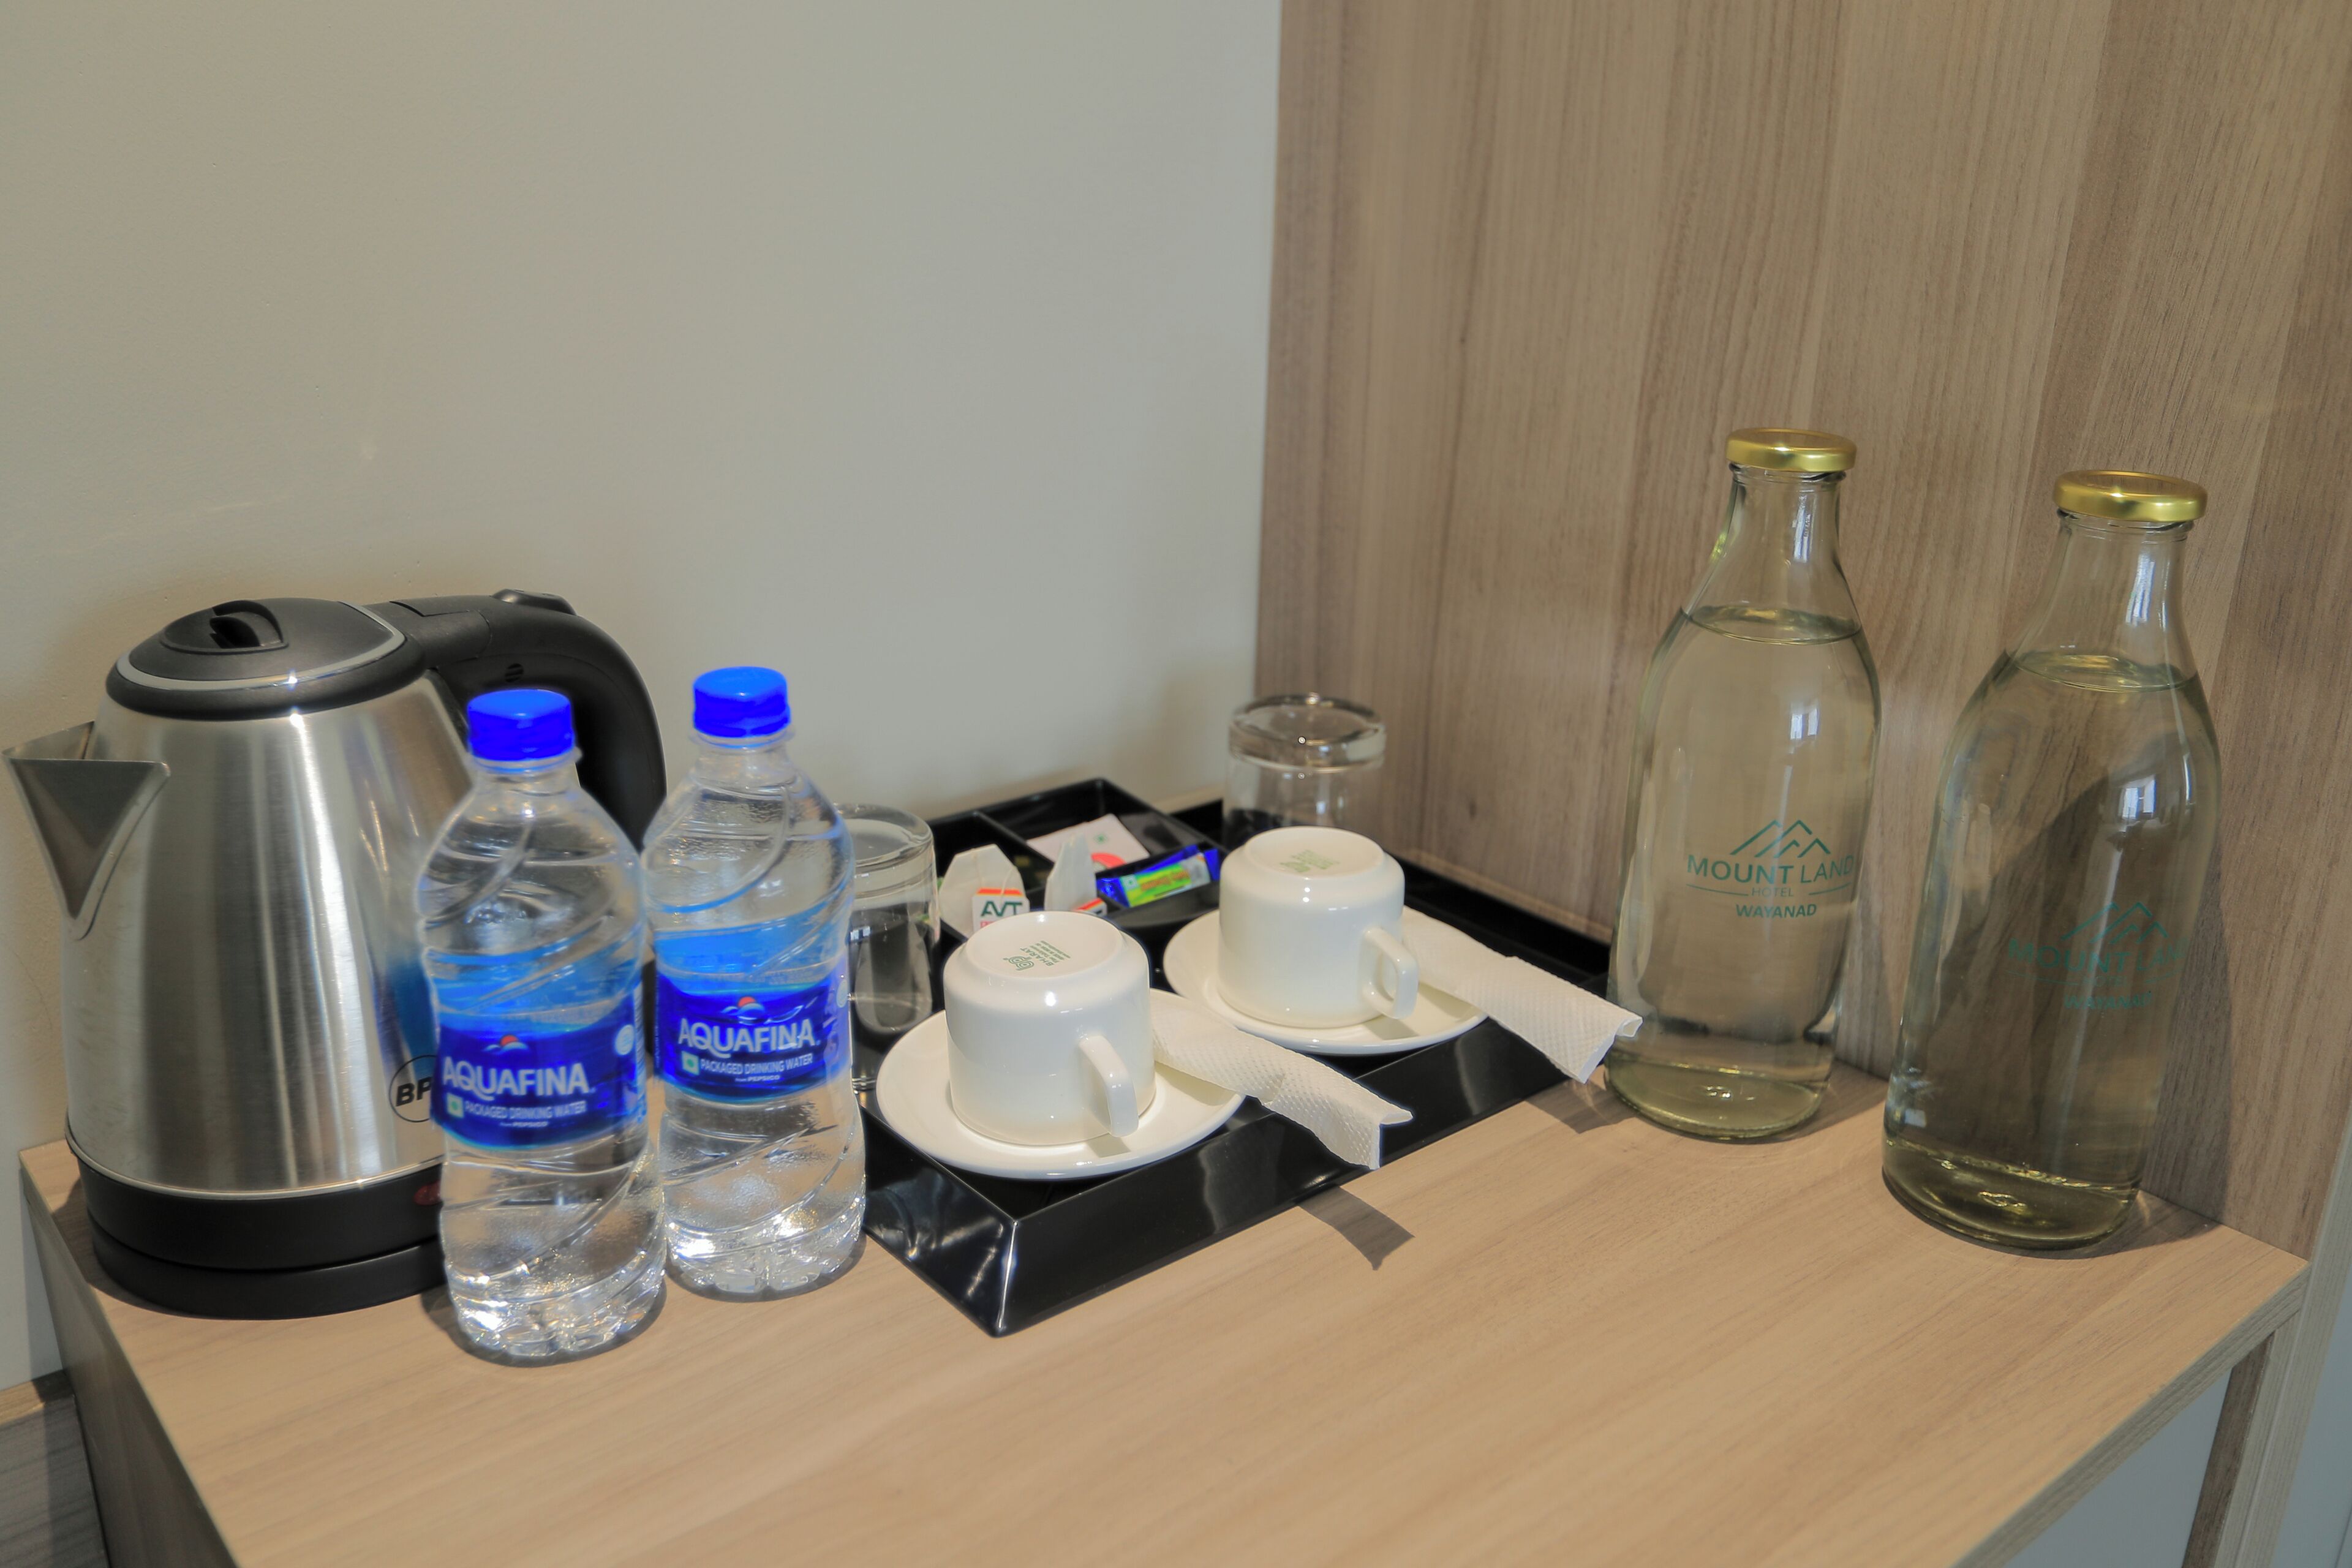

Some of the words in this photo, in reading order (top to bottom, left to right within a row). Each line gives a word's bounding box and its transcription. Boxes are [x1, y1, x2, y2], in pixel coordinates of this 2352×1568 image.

[1687, 854, 1794, 884] MOUNT
[1800, 854, 1855, 884] LAND
[1751, 887, 1794, 897] HOTEL
[981, 900, 1023, 917] AVT
[1735, 903, 1817, 919] WAYANAD
[2008, 937, 2132, 973] MOUNT
[2064, 992, 2152, 1011] WAYANAD
[678, 1017, 816, 1058] AQUAFINA
[700, 1058, 743, 1075] PACKAGED
[744, 1060, 785, 1075] DRINKING
[785, 1053, 813, 1071] WATER
[442, 1055, 590, 1101] AQUAFINA
[396, 1076, 432, 1107] BP
[465, 1101, 508, 1119] PACKAGED
[509, 1106, 552, 1120] DRINKING
[554, 1101, 587, 1118] WATER
